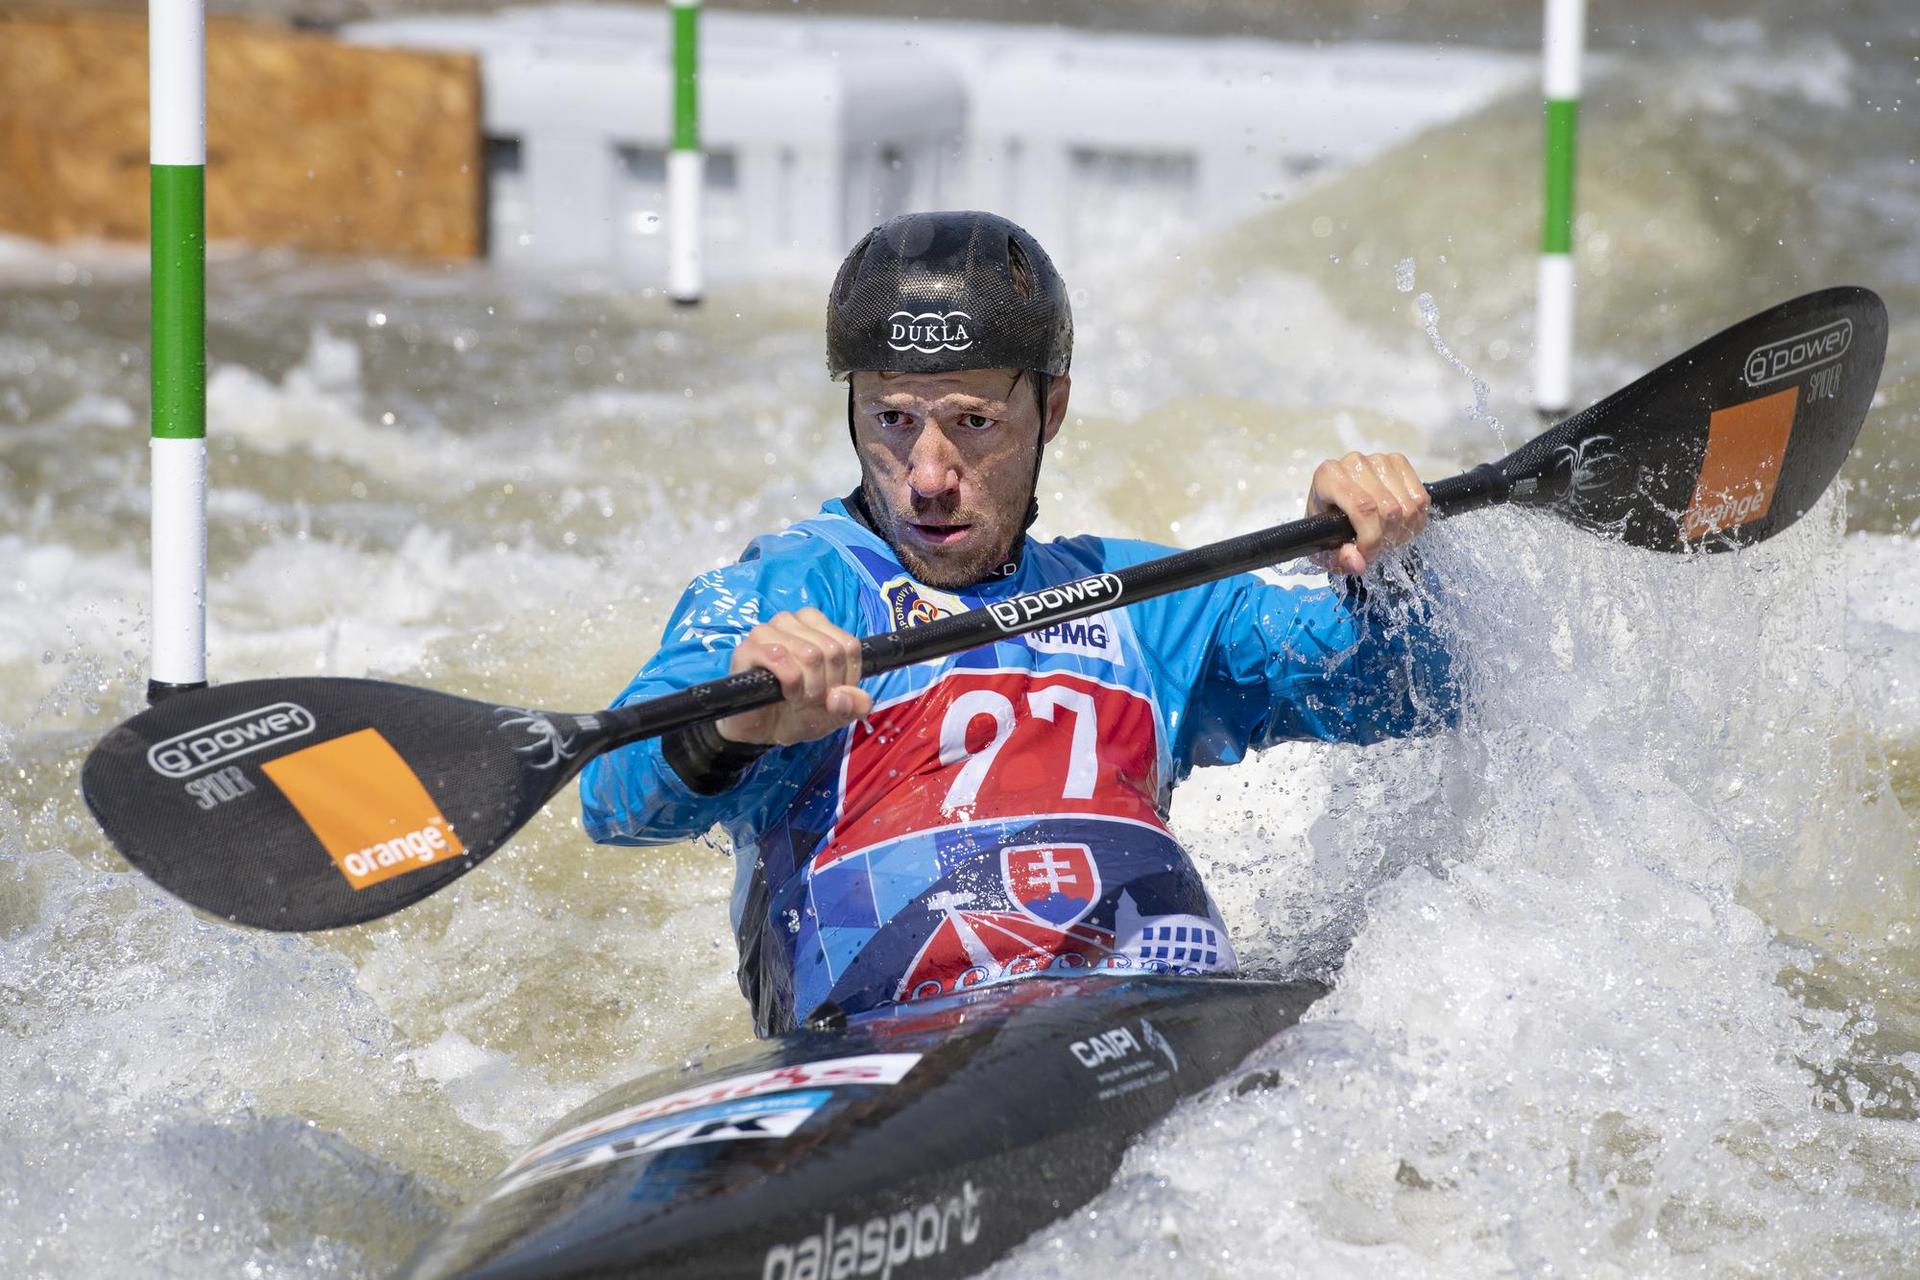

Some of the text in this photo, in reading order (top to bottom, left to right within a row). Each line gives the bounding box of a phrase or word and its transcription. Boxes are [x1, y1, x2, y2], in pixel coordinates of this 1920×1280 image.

[891, 323, 969, 342] DUKLA
[939, 685, 1099, 818] 97
[344, 826, 446, 876] orange
[1070, 1026, 1141, 1068] CAIPI
